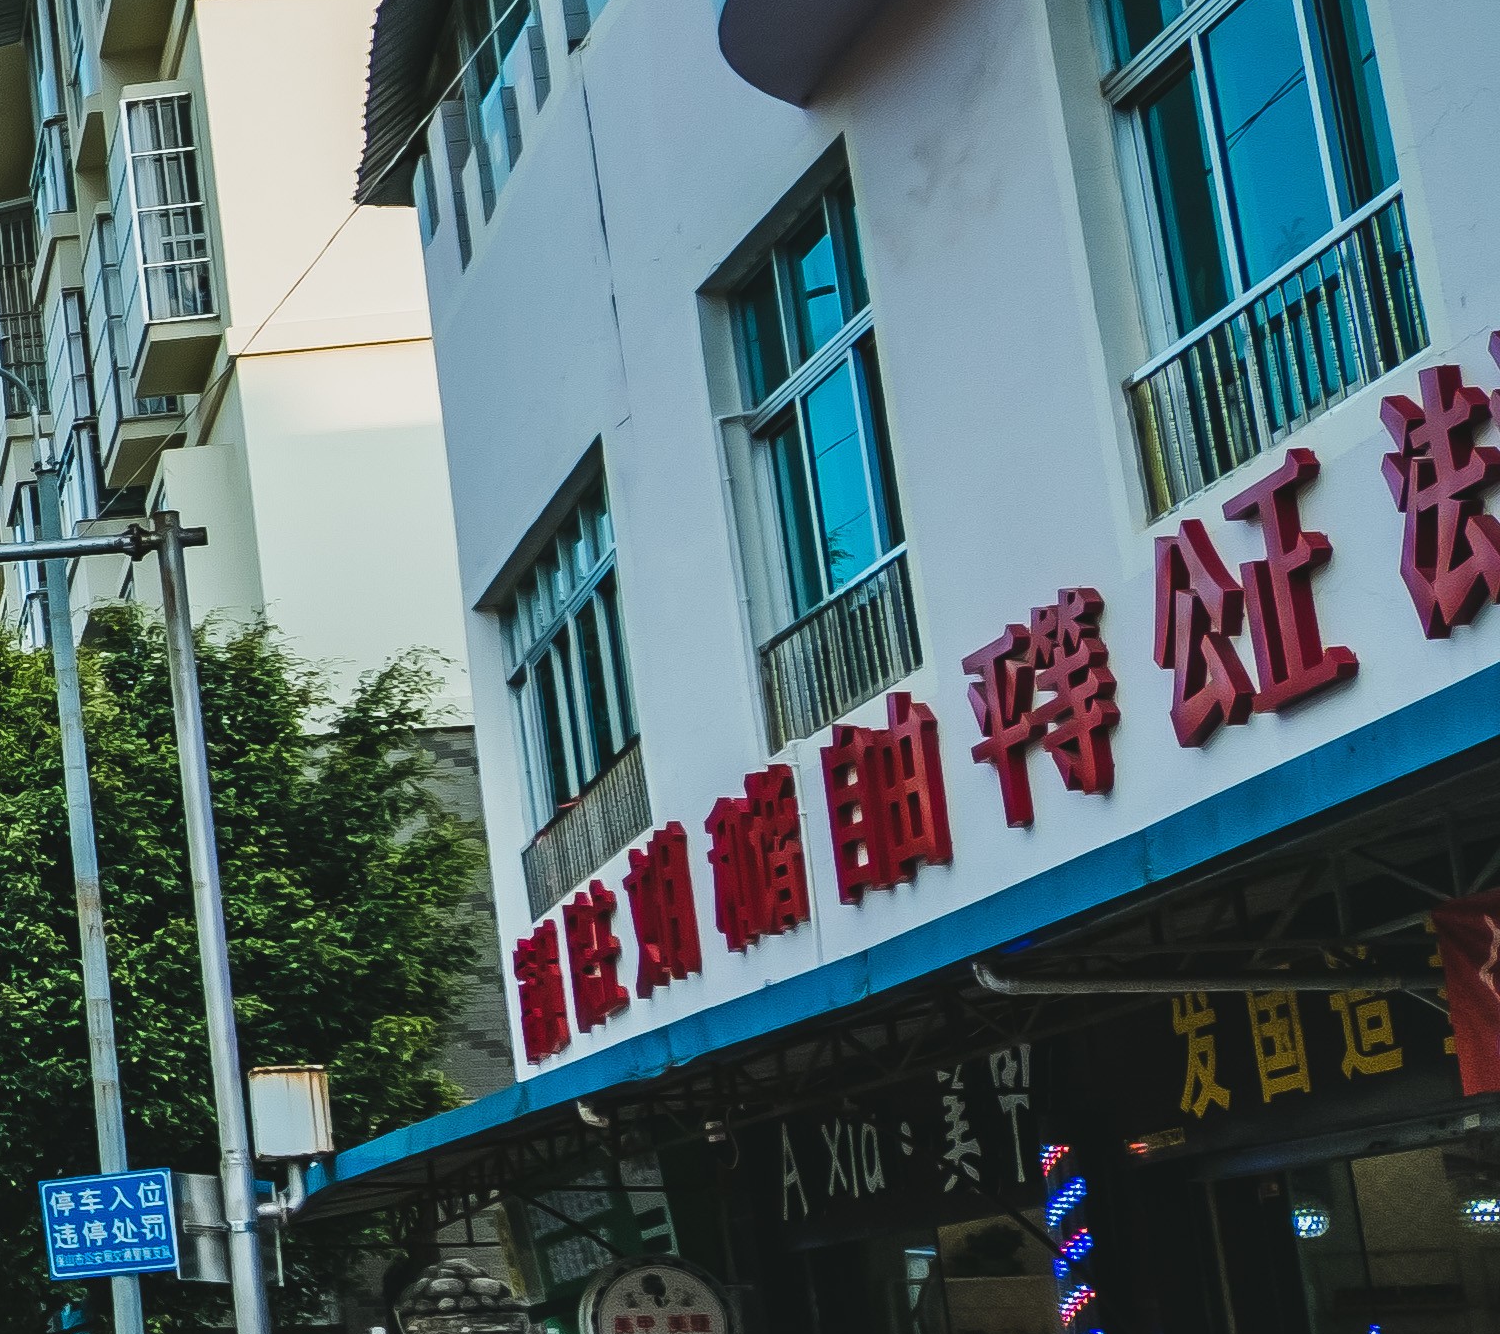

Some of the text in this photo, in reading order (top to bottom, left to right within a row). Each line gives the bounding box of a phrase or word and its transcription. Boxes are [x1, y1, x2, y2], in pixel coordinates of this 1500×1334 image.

[819, 689, 953, 905] 自由
[960, 585, 1124, 831] 平等
[1151, 446, 1362, 749] 公正
[49, 1180, 165, 1218] 停车入位
[52, 1213, 167, 1249] 违停处罚
